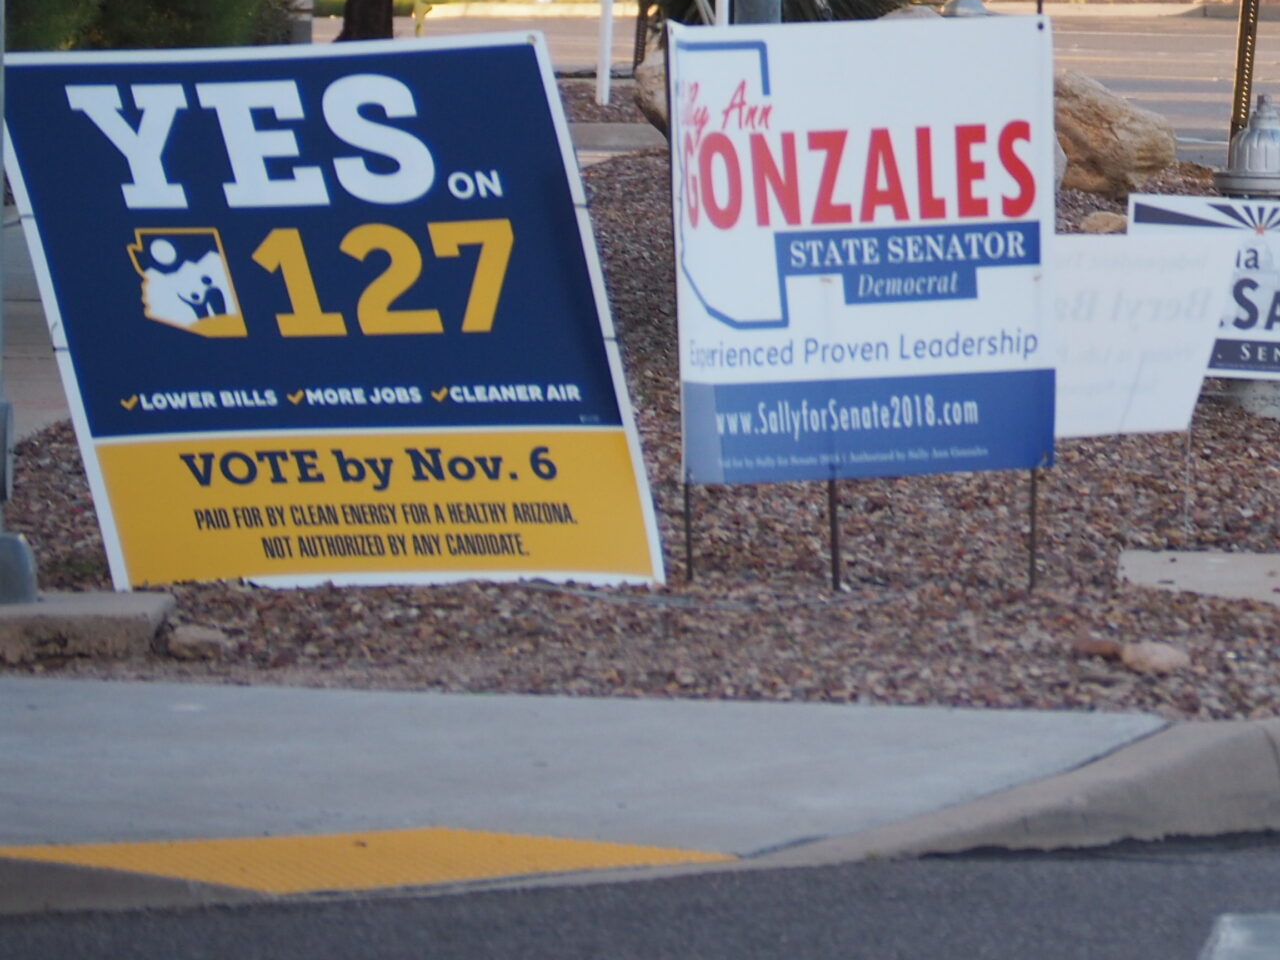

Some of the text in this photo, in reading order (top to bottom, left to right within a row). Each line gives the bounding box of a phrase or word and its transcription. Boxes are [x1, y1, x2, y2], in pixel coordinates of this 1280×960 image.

[722, 79, 773, 130] Ann
[65, 73, 503, 209] YES ON
[683, 119, 1036, 230] GONZALES
[790, 238, 881, 269] STATE
[887, 230, 1027, 264] SENATOR
[251, 218, 514, 338] 127
[857, 270, 959, 299] Democrat
[804, 337, 889, 364] Proven
[900, 326, 1039, 361] Leadership
[138, 383, 582, 411] LOWER BILLS MORE JOBS CLEANER AIR
[179, 445, 558, 492] VOTE by Nov. 6
[194, 502, 578, 530] PAID FOR BY CLEAN ENERGY FOR A HEALTHY ARIZONA.
[261, 532, 531, 559] NOT AUTHORIZED BY ANY CANDIDATE.
